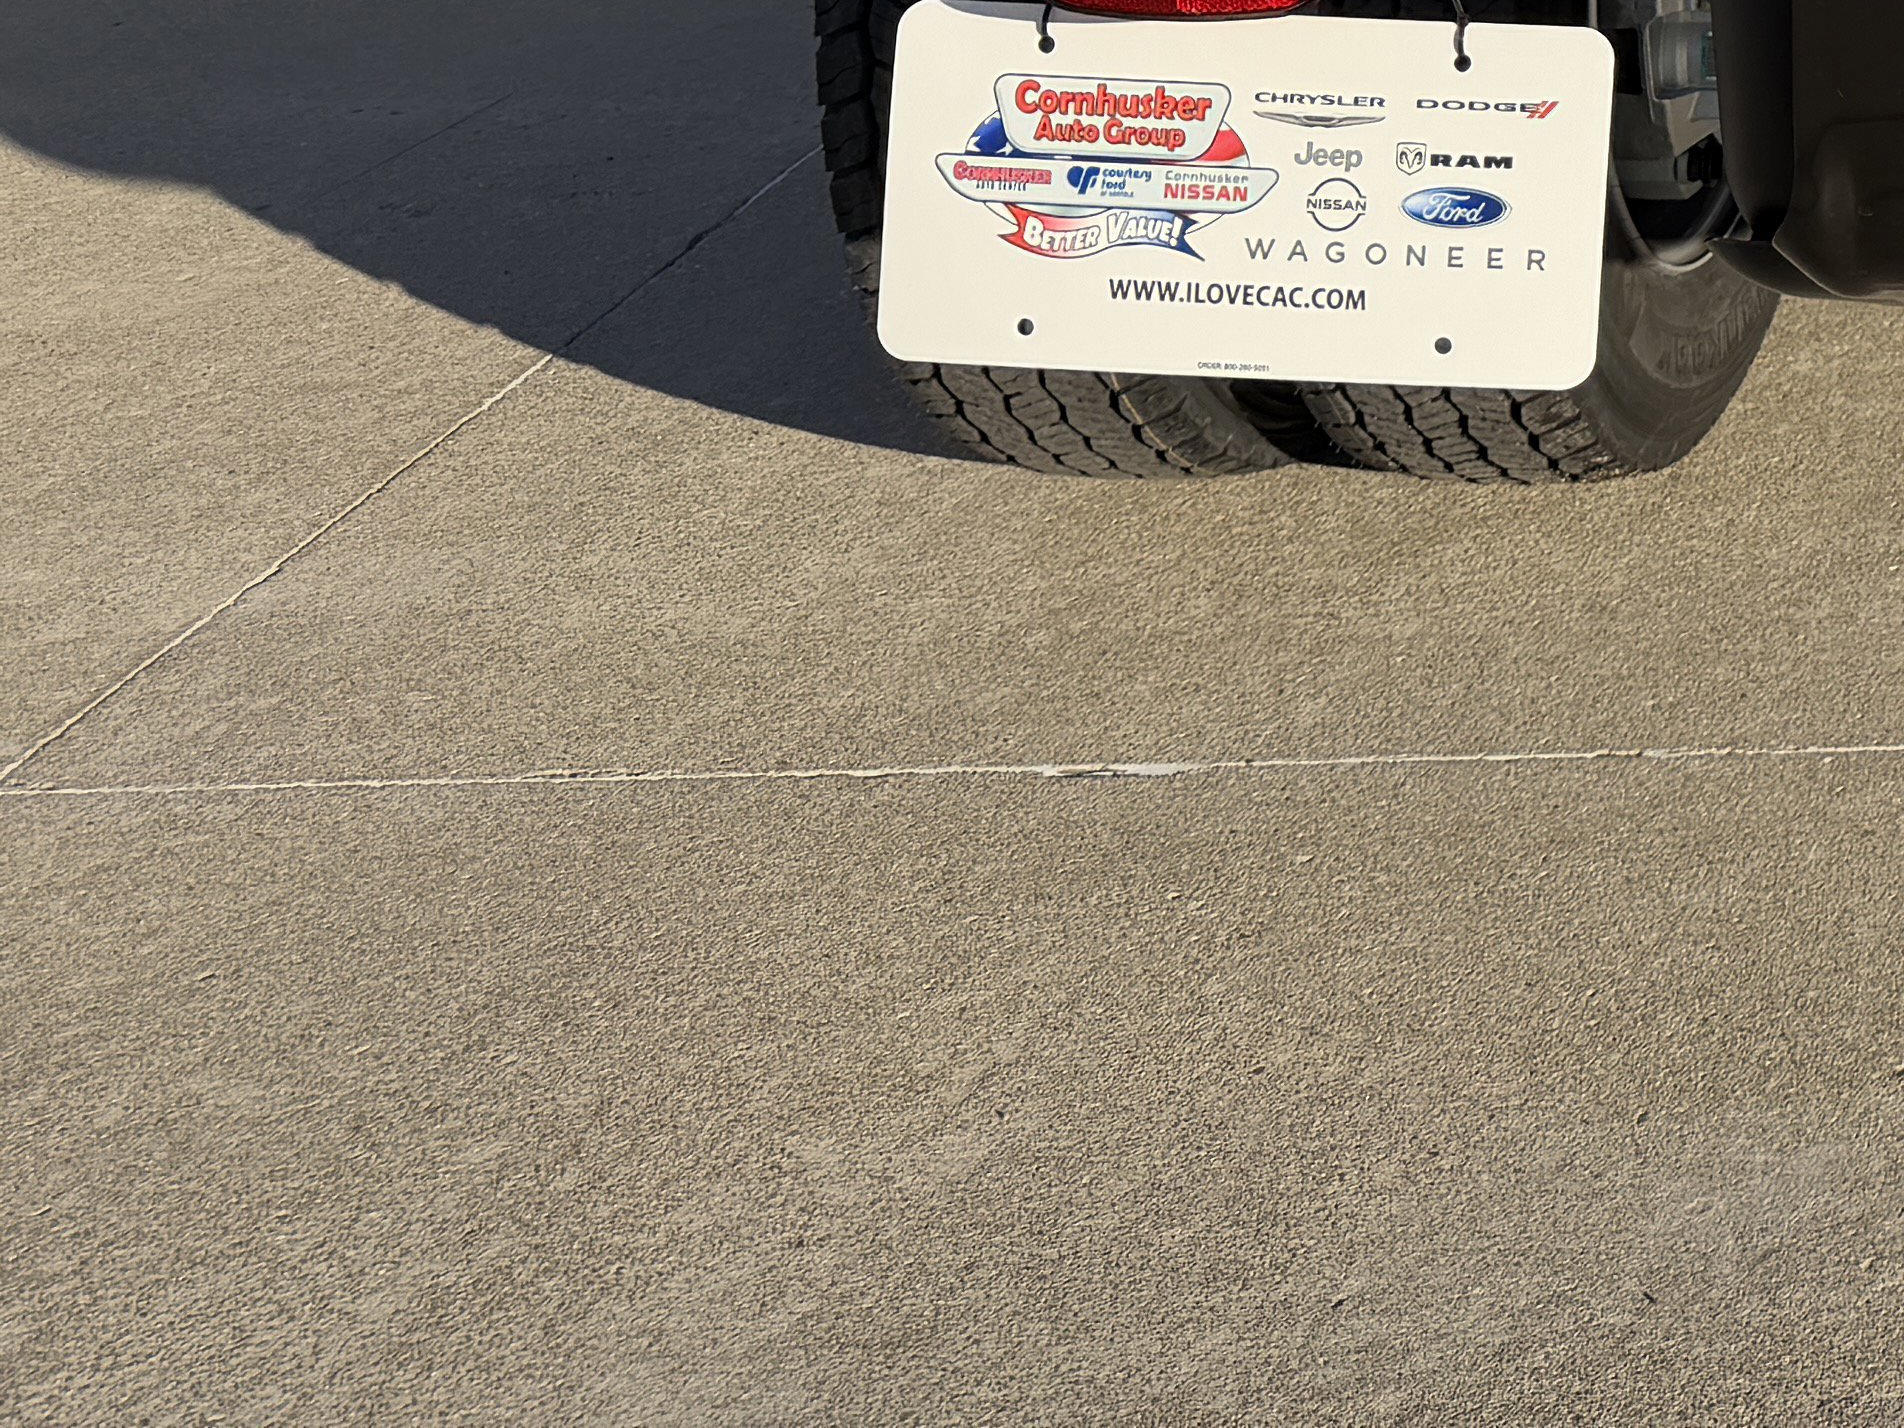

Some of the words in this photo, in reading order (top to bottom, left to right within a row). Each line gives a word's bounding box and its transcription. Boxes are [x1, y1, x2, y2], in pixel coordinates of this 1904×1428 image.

[1015, 79, 1212, 122] Cornhusker
[1254, 92, 1386, 108] CHRYSLER
[1416, 98, 1541, 113] DODGE
[1033, 114, 1100, 142] Auto
[1103, 118, 1186, 150] Group
[1294, 141, 1363, 172] Jeep
[1430, 153, 1514, 169] RAM
[1164, 169, 1249, 184] Cornhusker
[1163, 183, 1249, 202] NISSAN
[1306, 197, 1367, 212] NISSAN
[1422, 192, 1486, 224] Ford
[1023, 215, 1101, 253] BETTER
[1106, 210, 1185, 248] VALUE!
[1244, 237, 1547, 272] WAGONEER
[1108, 277, 1367, 311] WWW.ILOVECAC.COM
